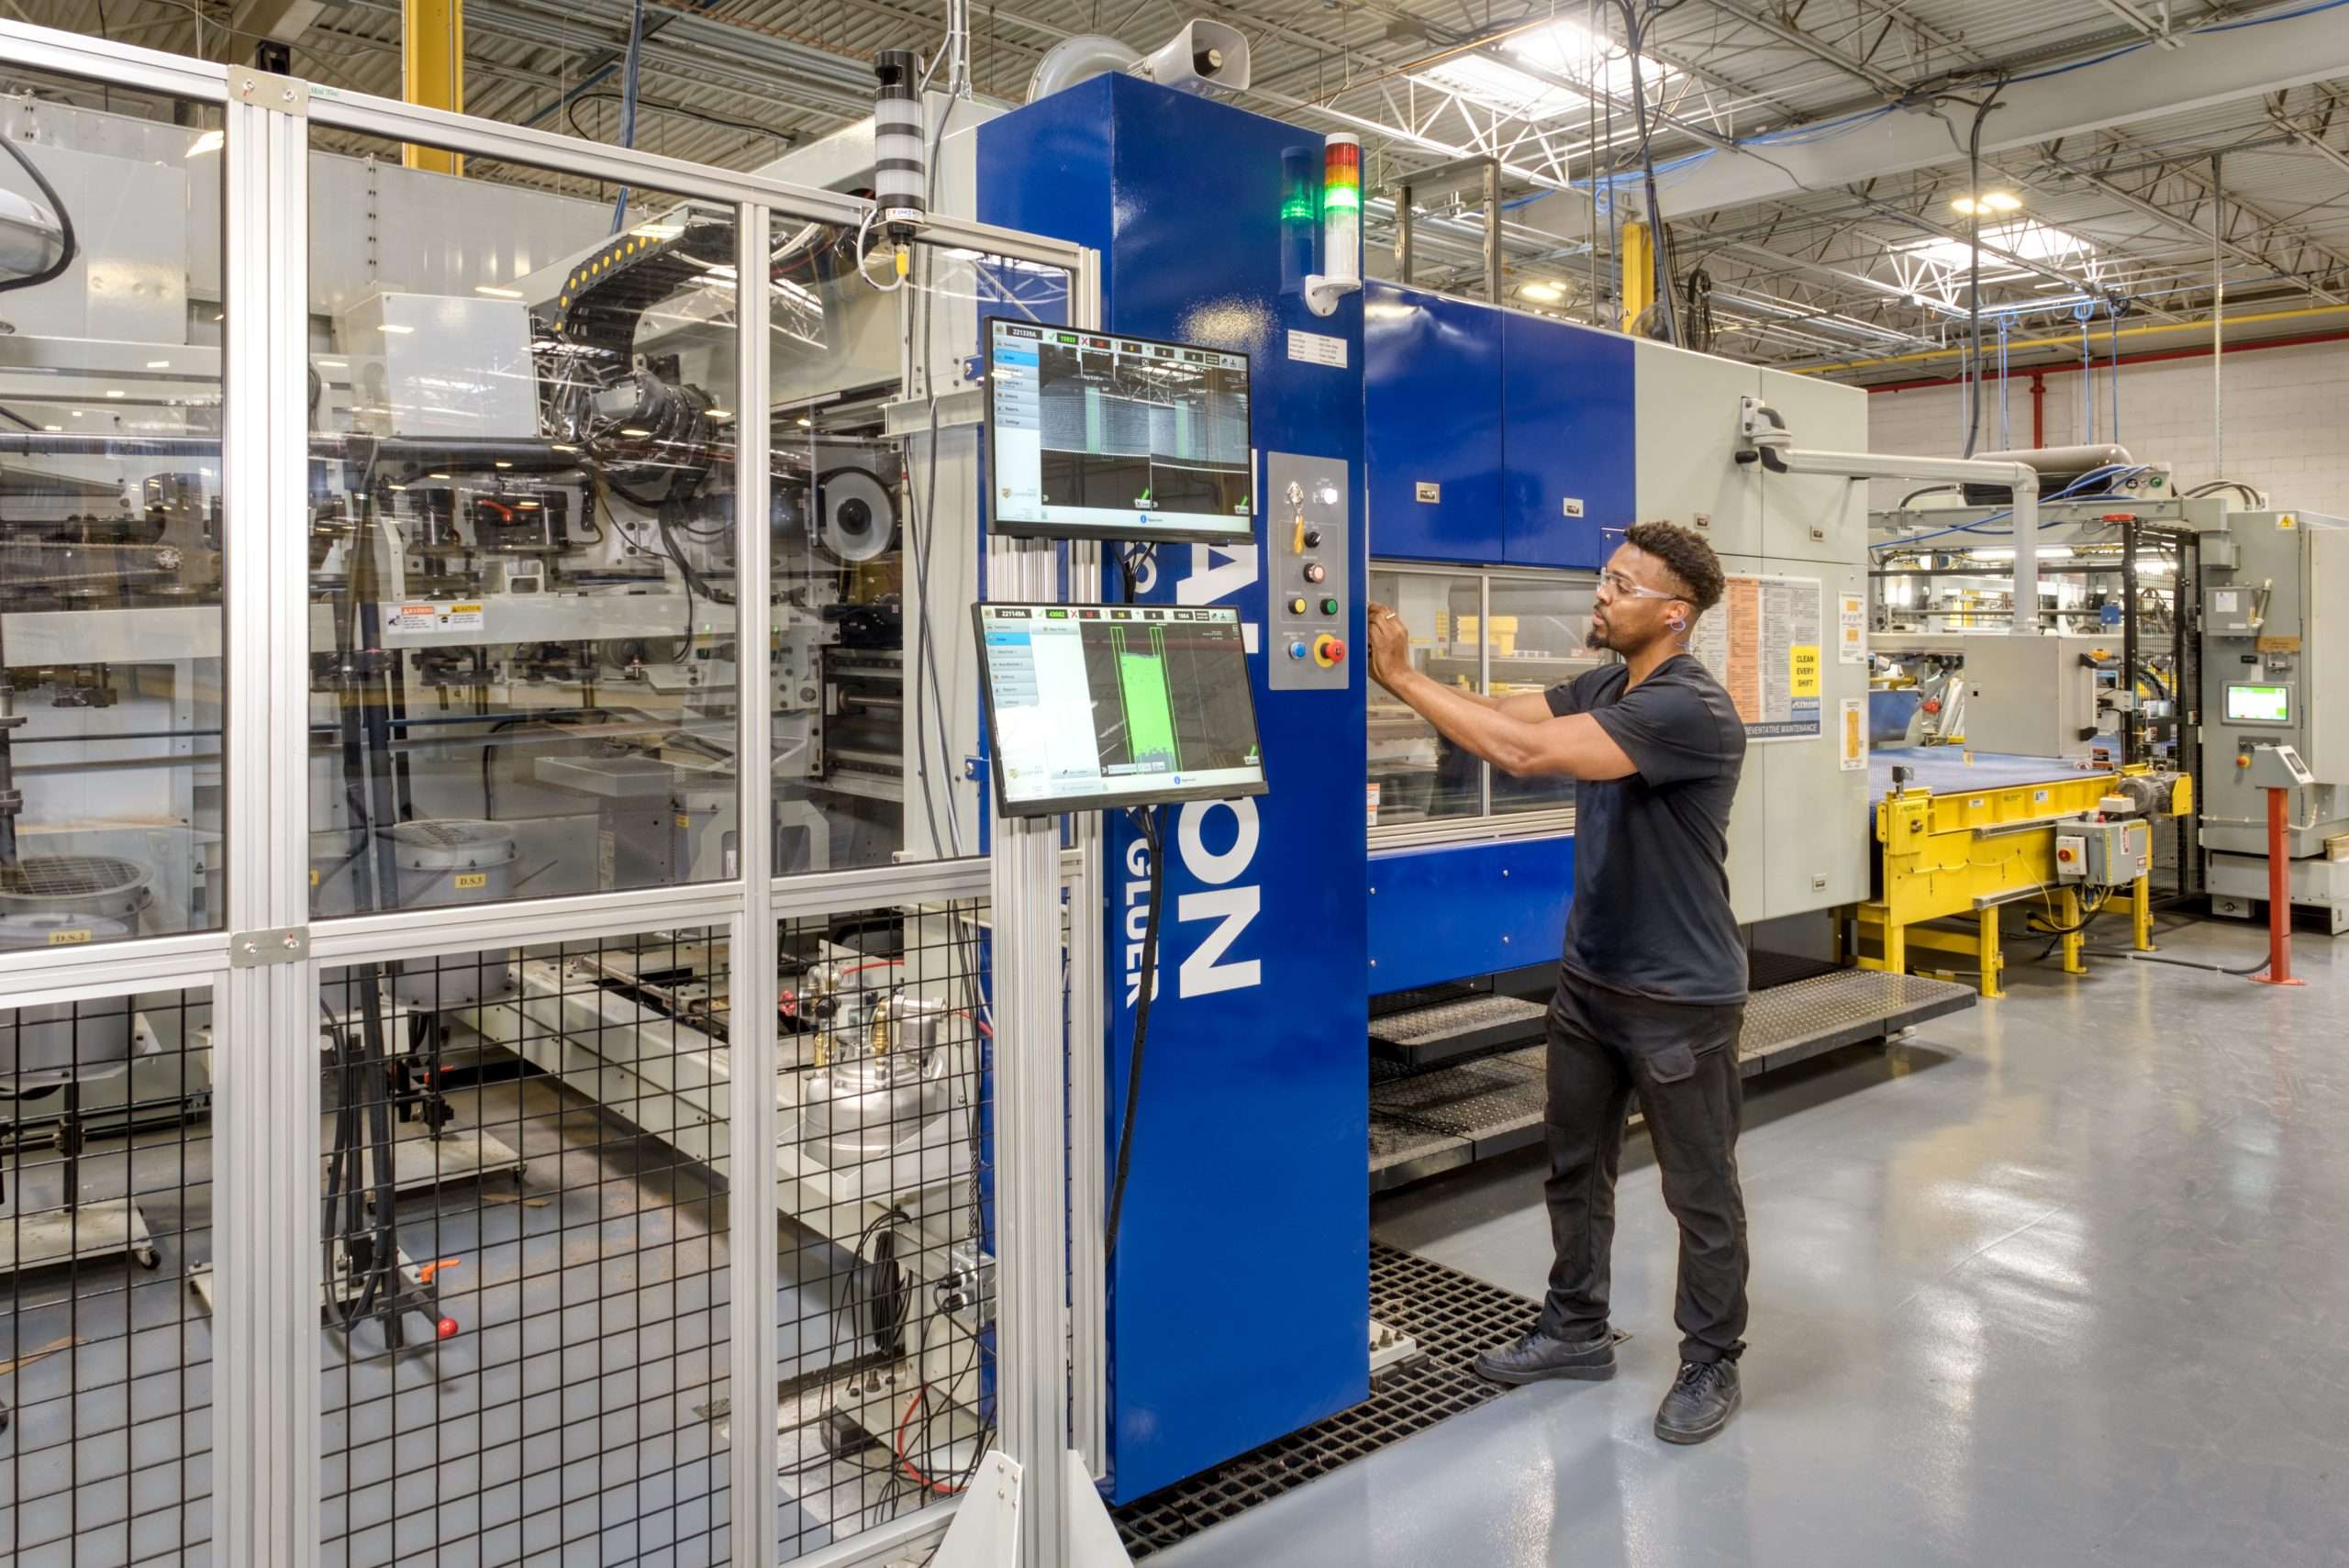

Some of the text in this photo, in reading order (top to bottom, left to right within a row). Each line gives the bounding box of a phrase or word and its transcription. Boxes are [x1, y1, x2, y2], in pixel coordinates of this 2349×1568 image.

[1797, 667, 1814, 675] EVERY
[1798, 679, 1814, 687] SHIFT
[1744, 722, 1818, 735] REVENTATIVE MAINTENANCE
